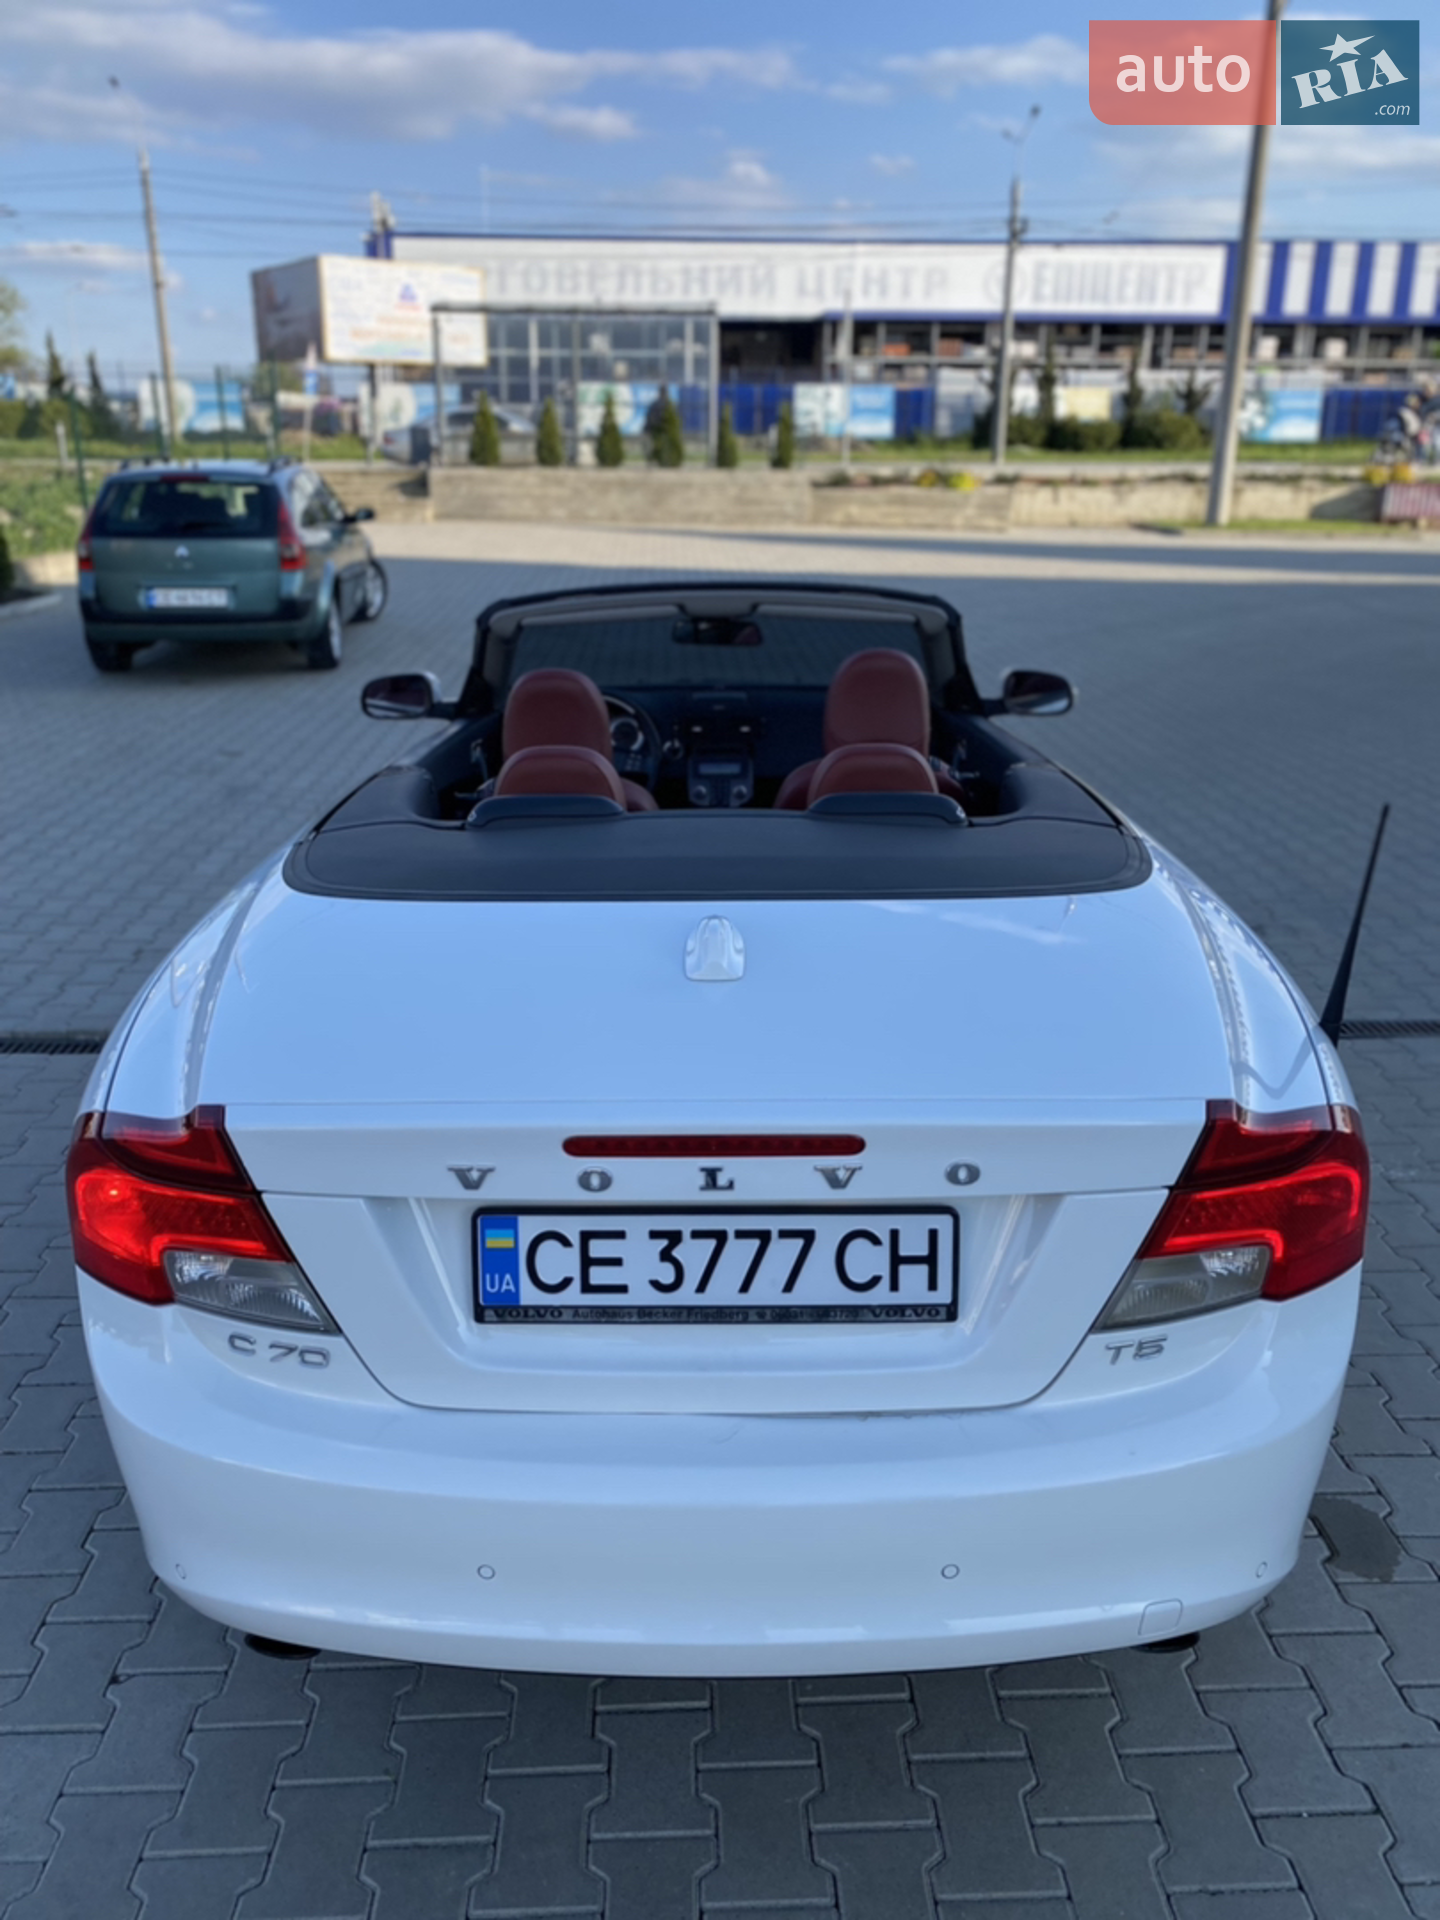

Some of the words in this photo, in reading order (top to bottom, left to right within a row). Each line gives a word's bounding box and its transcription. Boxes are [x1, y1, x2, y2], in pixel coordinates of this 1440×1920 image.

[796, 264, 949, 302] ЦЕНТР
[448, 1162, 981, 1193] VOLVO
[525, 1230, 629, 1294] CE
[647, 1230, 817, 1294] 3777
[834, 1228, 939, 1293] CH
[485, 1274, 516, 1293] UA
[493, 1307, 563, 1319] VOLVO
[869, 1306, 940, 1319] VOLVO
[1105, 1334, 1169, 1366] T5
